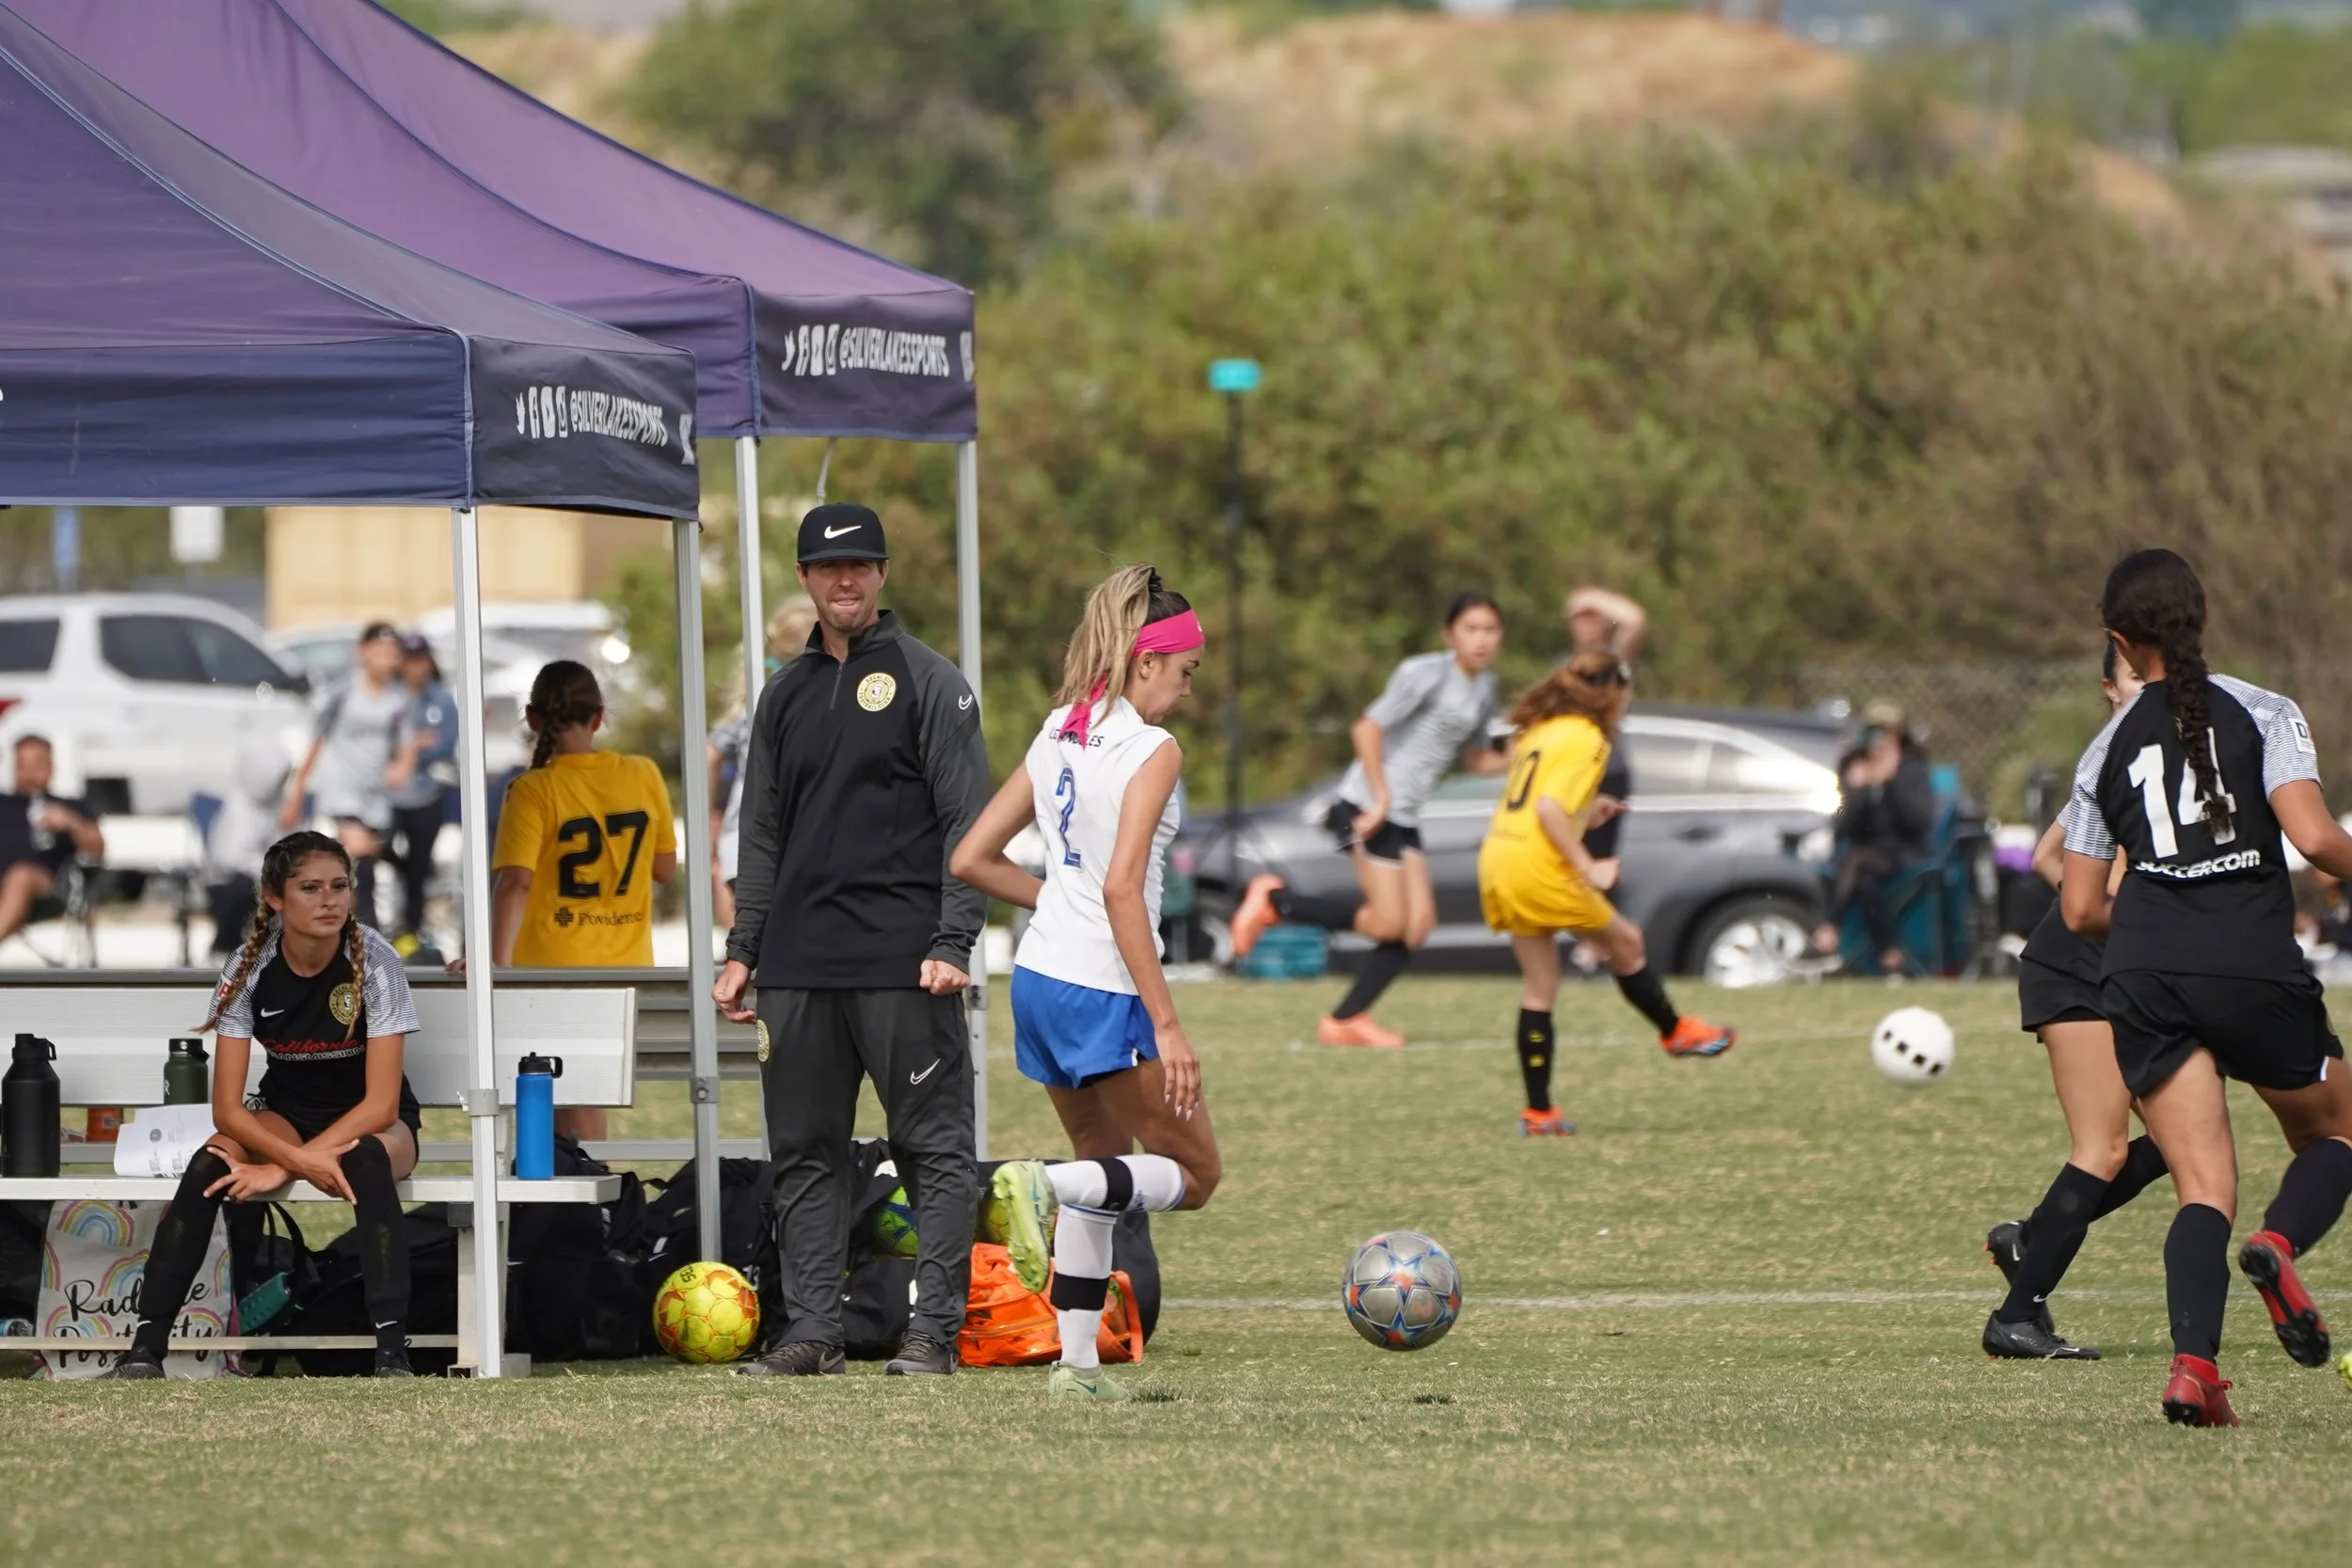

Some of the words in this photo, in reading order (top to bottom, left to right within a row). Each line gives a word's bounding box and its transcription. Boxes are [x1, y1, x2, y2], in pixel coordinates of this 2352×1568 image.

[1056, 764, 1083, 870] 2
[2127, 727, 2237, 859] 14
[558, 809, 649, 898] 27
[266, 1044, 365, 1061] ANSMISSION
